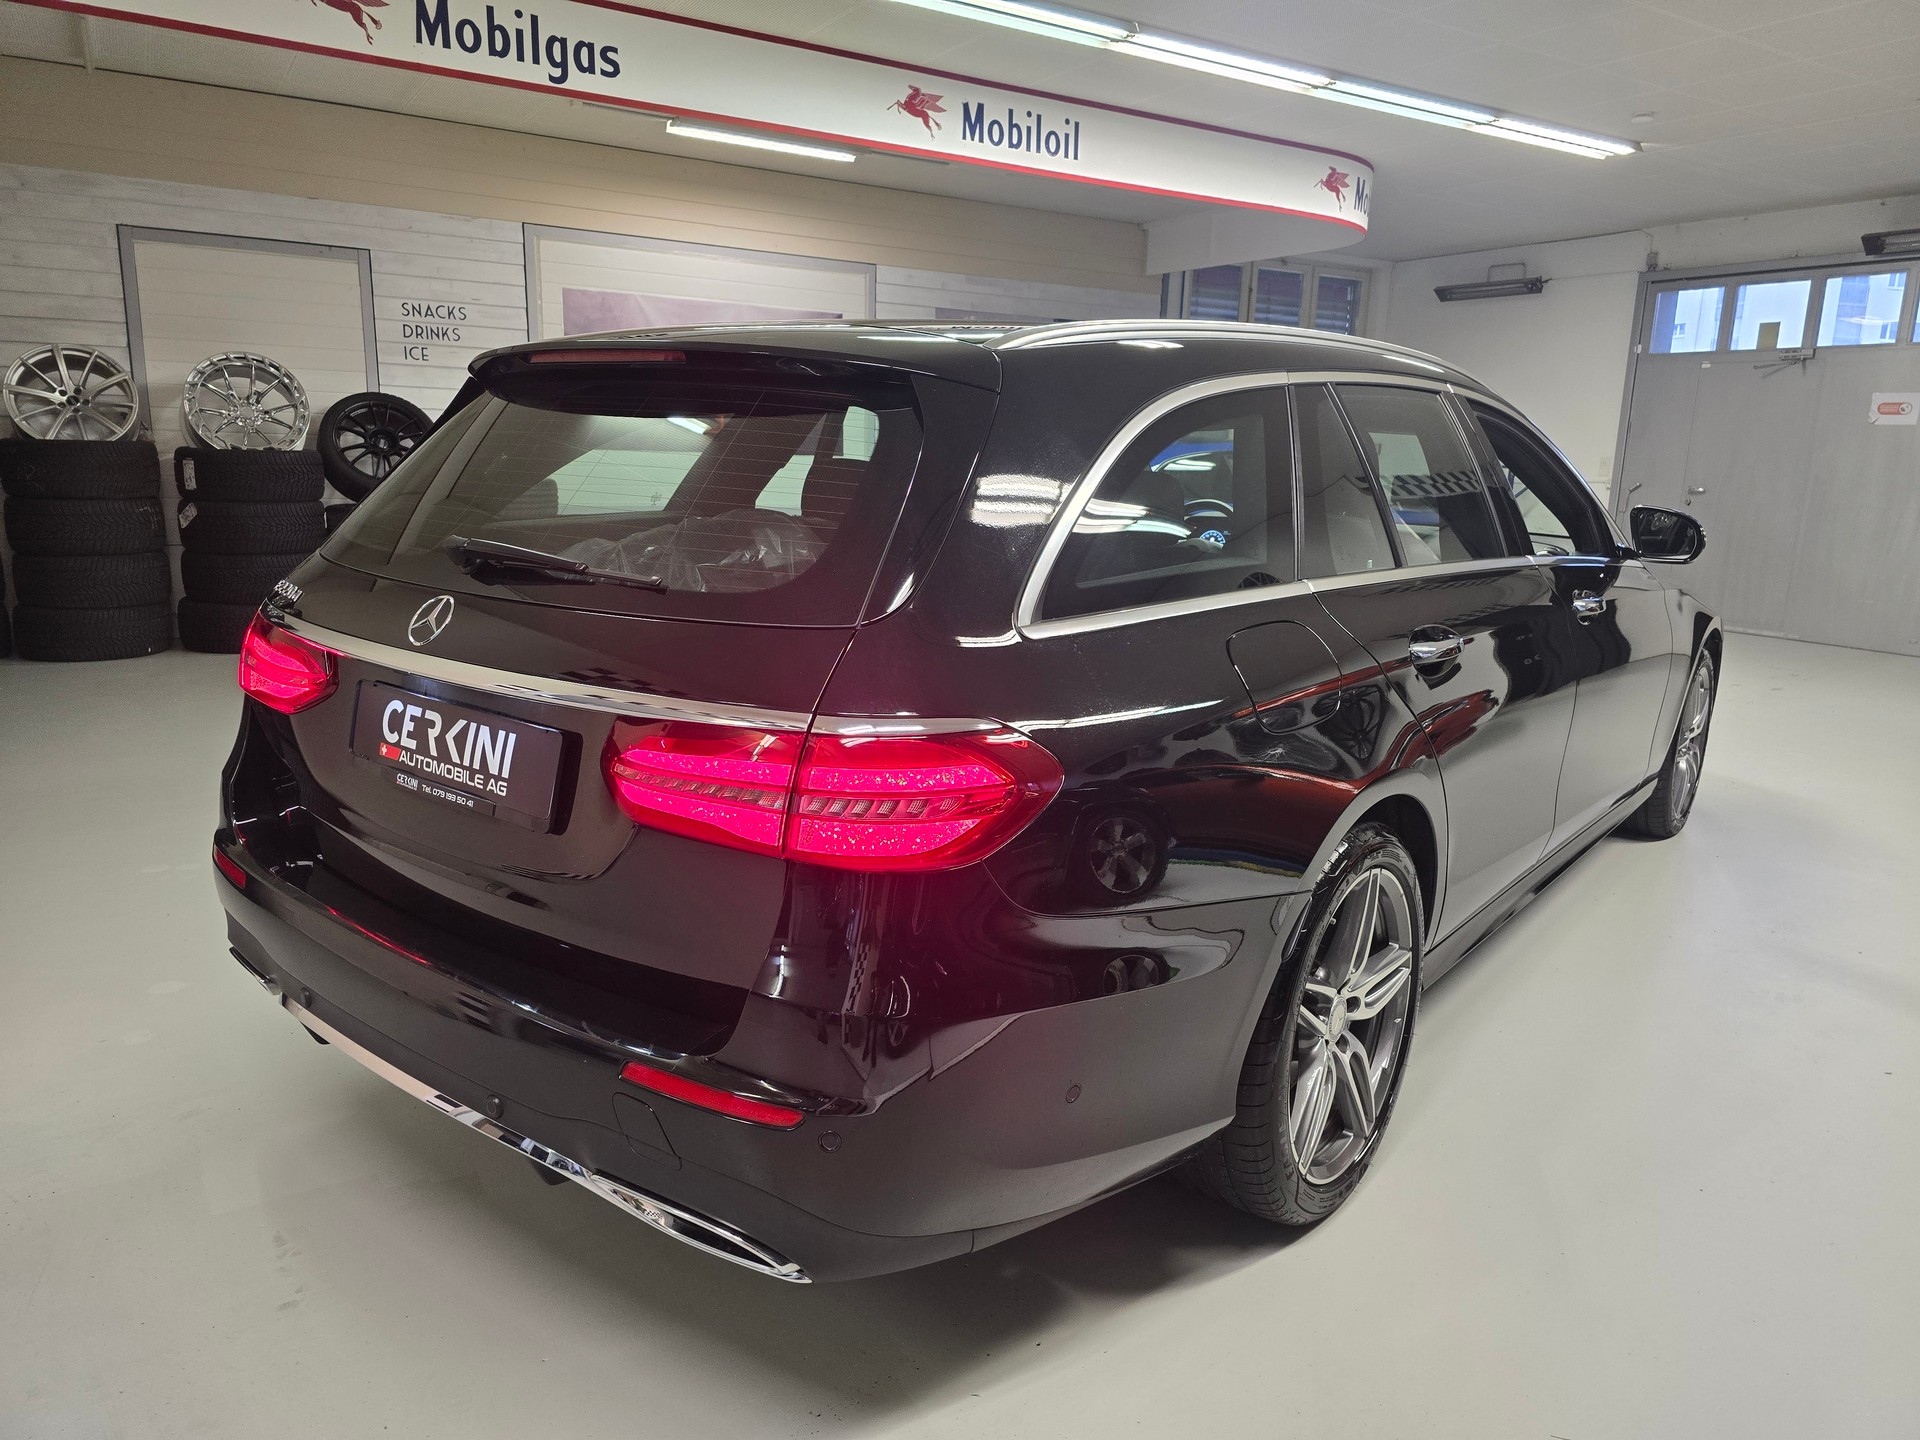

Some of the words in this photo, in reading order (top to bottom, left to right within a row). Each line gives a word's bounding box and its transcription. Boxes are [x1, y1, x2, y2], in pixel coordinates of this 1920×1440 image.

[415, 0, 621, 84] Mobilgas
[961, 101, 1080, 161] Mobiloil
[1353, 176, 1371, 215] Mo
[401, 302, 467, 321] SNACKS
[402, 323, 461, 342] DRINKS
[403, 345, 430, 361] ICE
[382, 699, 517, 779] CERKINI
[399, 750, 484, 789] AUTOMOBILE
[486, 779, 508, 796] AG
[432, 788, 445, 798] 079
[456, 796, 466, 805] 50
[466, 799, 474, 808] 41
